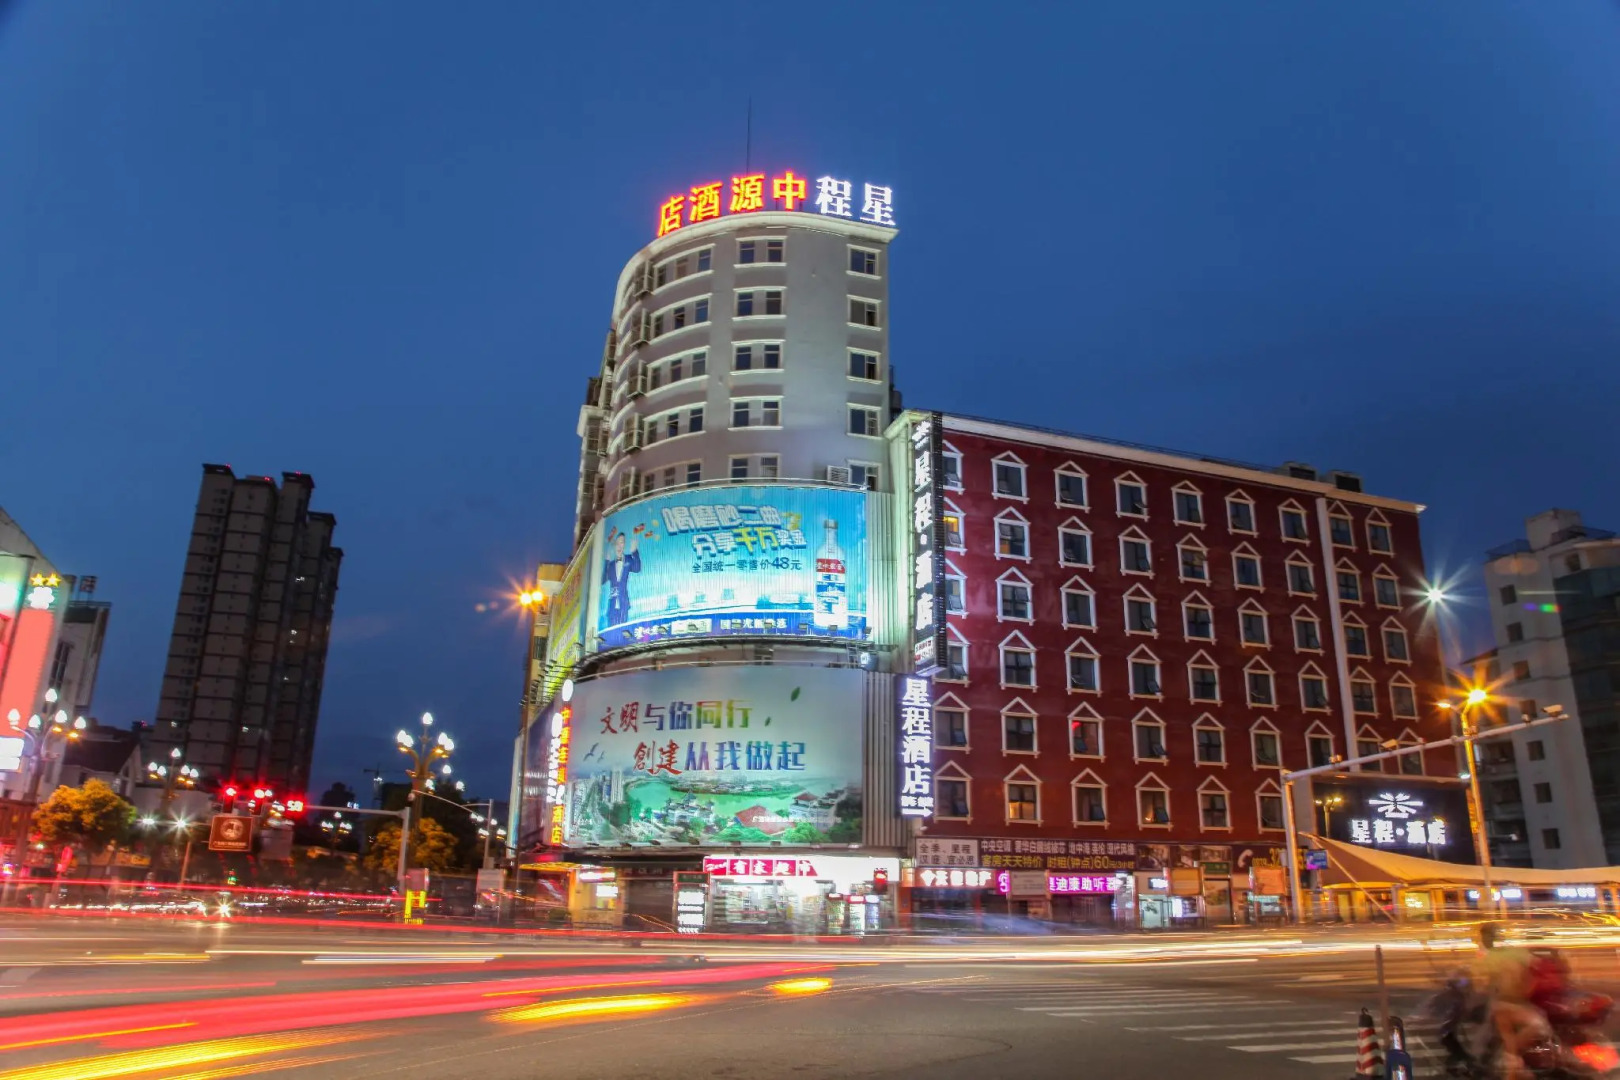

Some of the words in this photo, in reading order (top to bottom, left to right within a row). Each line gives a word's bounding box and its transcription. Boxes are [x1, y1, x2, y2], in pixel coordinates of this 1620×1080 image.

[600, 699, 753, 734] 文明与你同行
[902, 678, 932, 794] 星程酒店
[982, 855, 1042, 868] 客房天天特价
